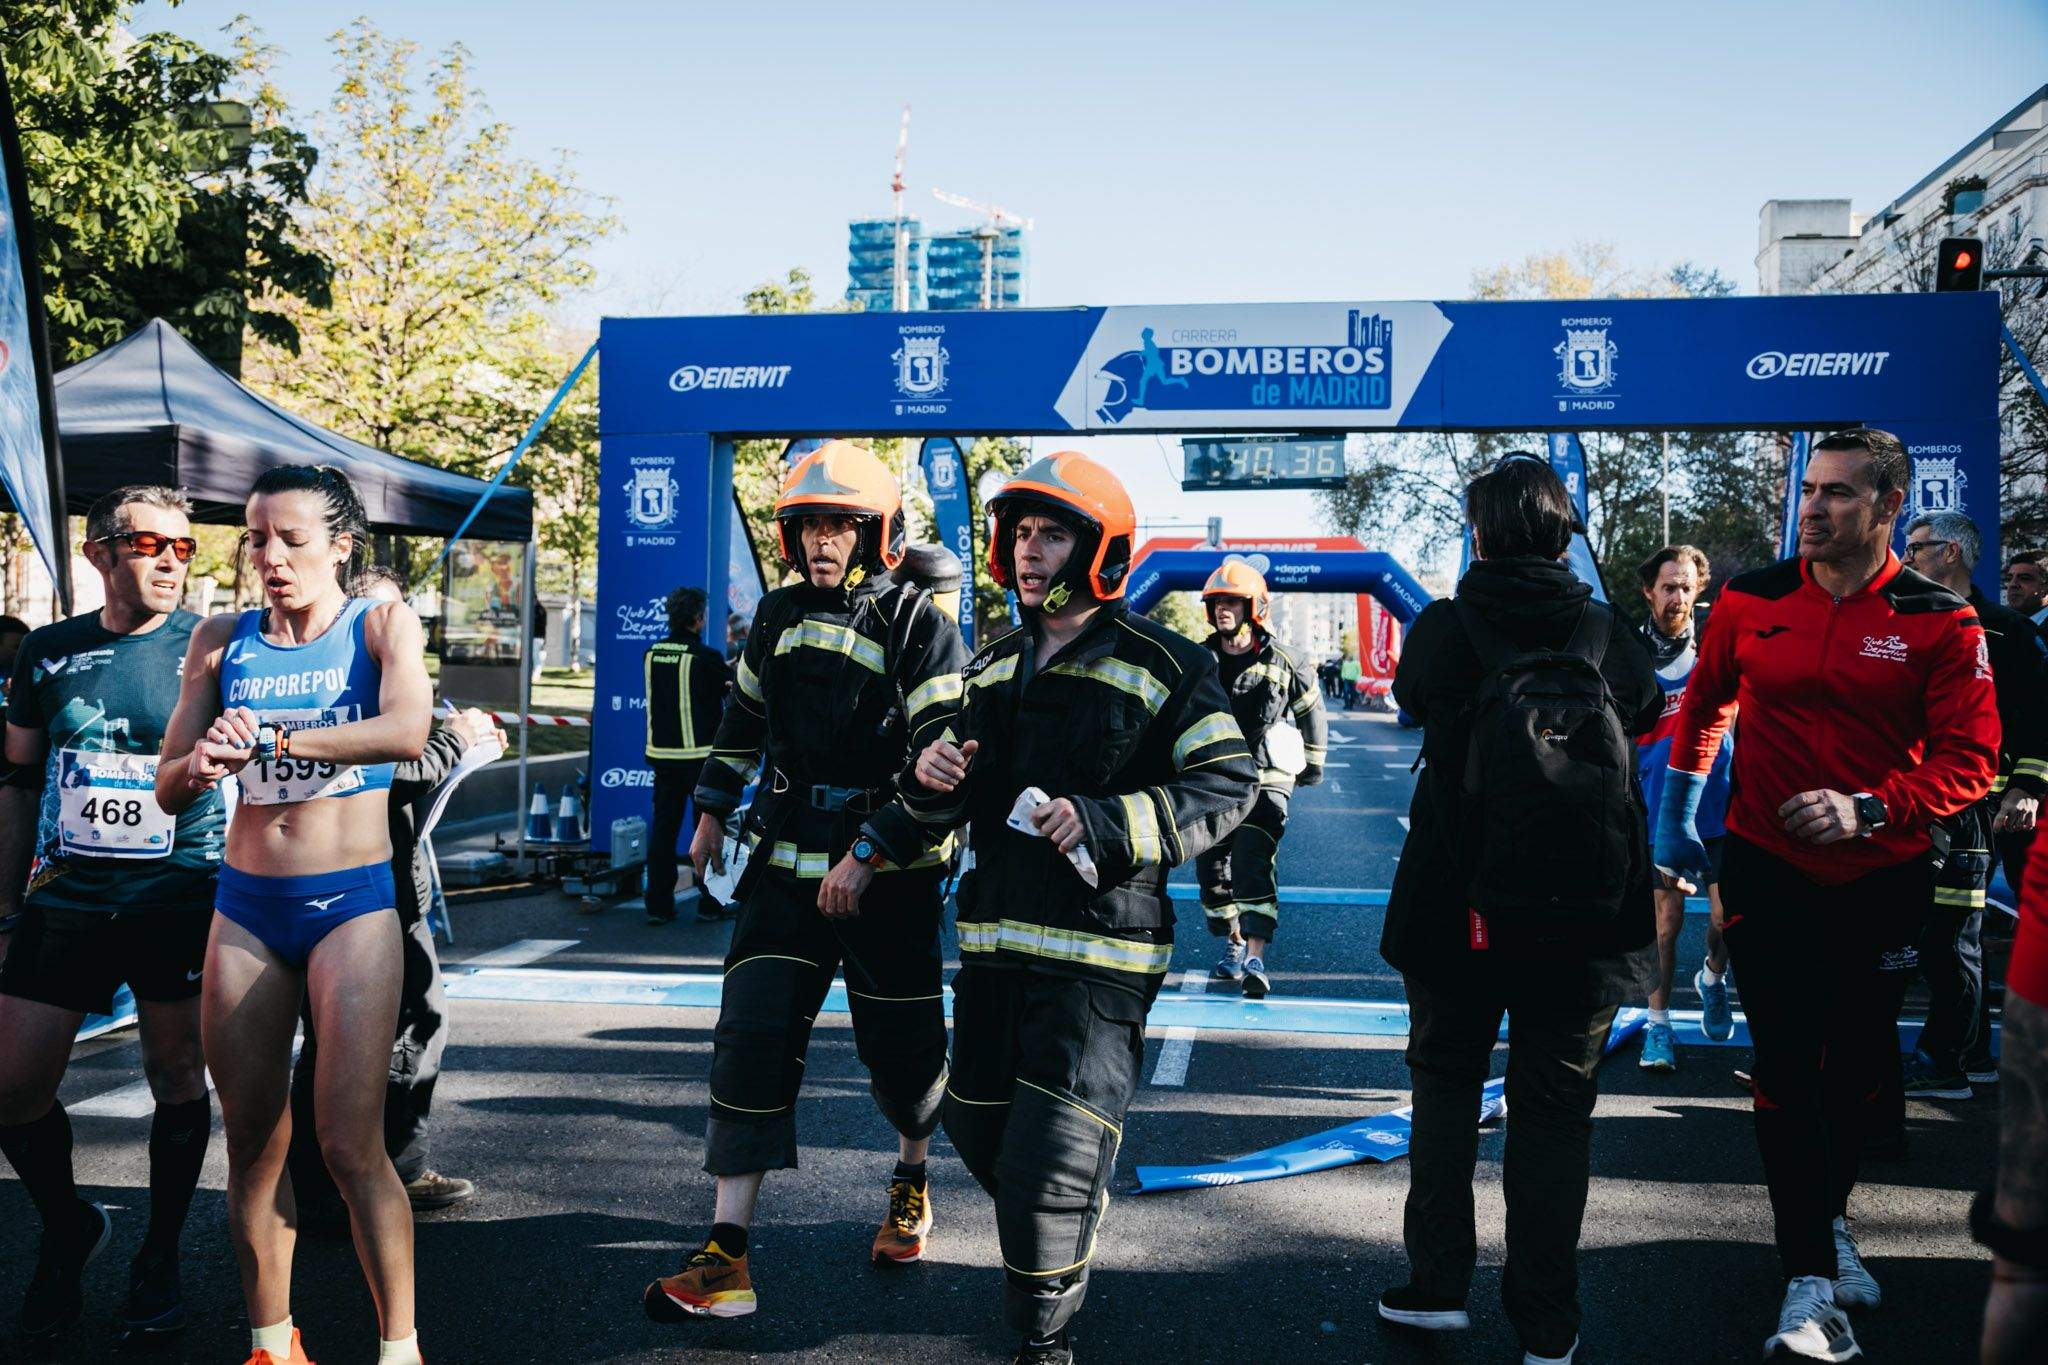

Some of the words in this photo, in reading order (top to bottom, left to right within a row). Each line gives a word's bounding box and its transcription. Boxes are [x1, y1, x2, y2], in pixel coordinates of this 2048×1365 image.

[898, 325, 946, 334] BOMBEROS
[1561, 317, 1613, 327] BOMBEROS
[1171, 328, 1237, 344] CARRERA
[1171, 347, 1385, 375] BOMBEROS
[1784, 351, 1890, 377] ENERVIT
[701, 365, 792, 389] ENERVIT
[1252, 376, 1281, 406] de
[1289, 376, 1385, 406] MADRID
[907, 404, 947, 414] MADRID
[1572, 400, 1616, 411] MADRID
[1907, 444, 1962, 454] BOMBEROS
[629, 456, 676, 466] BOMBEROS
[637, 536, 676, 546] MADRID
[1391, 581, 1423, 613] MADRID
[616, 604, 646, 619] Club
[621, 617, 670, 634] Deporti
[1862, 636, 1884, 648] Club
[229, 667, 352, 703] CORPOREPOL
[254, 756, 337, 783] 1599
[80, 796, 143, 827] 468
